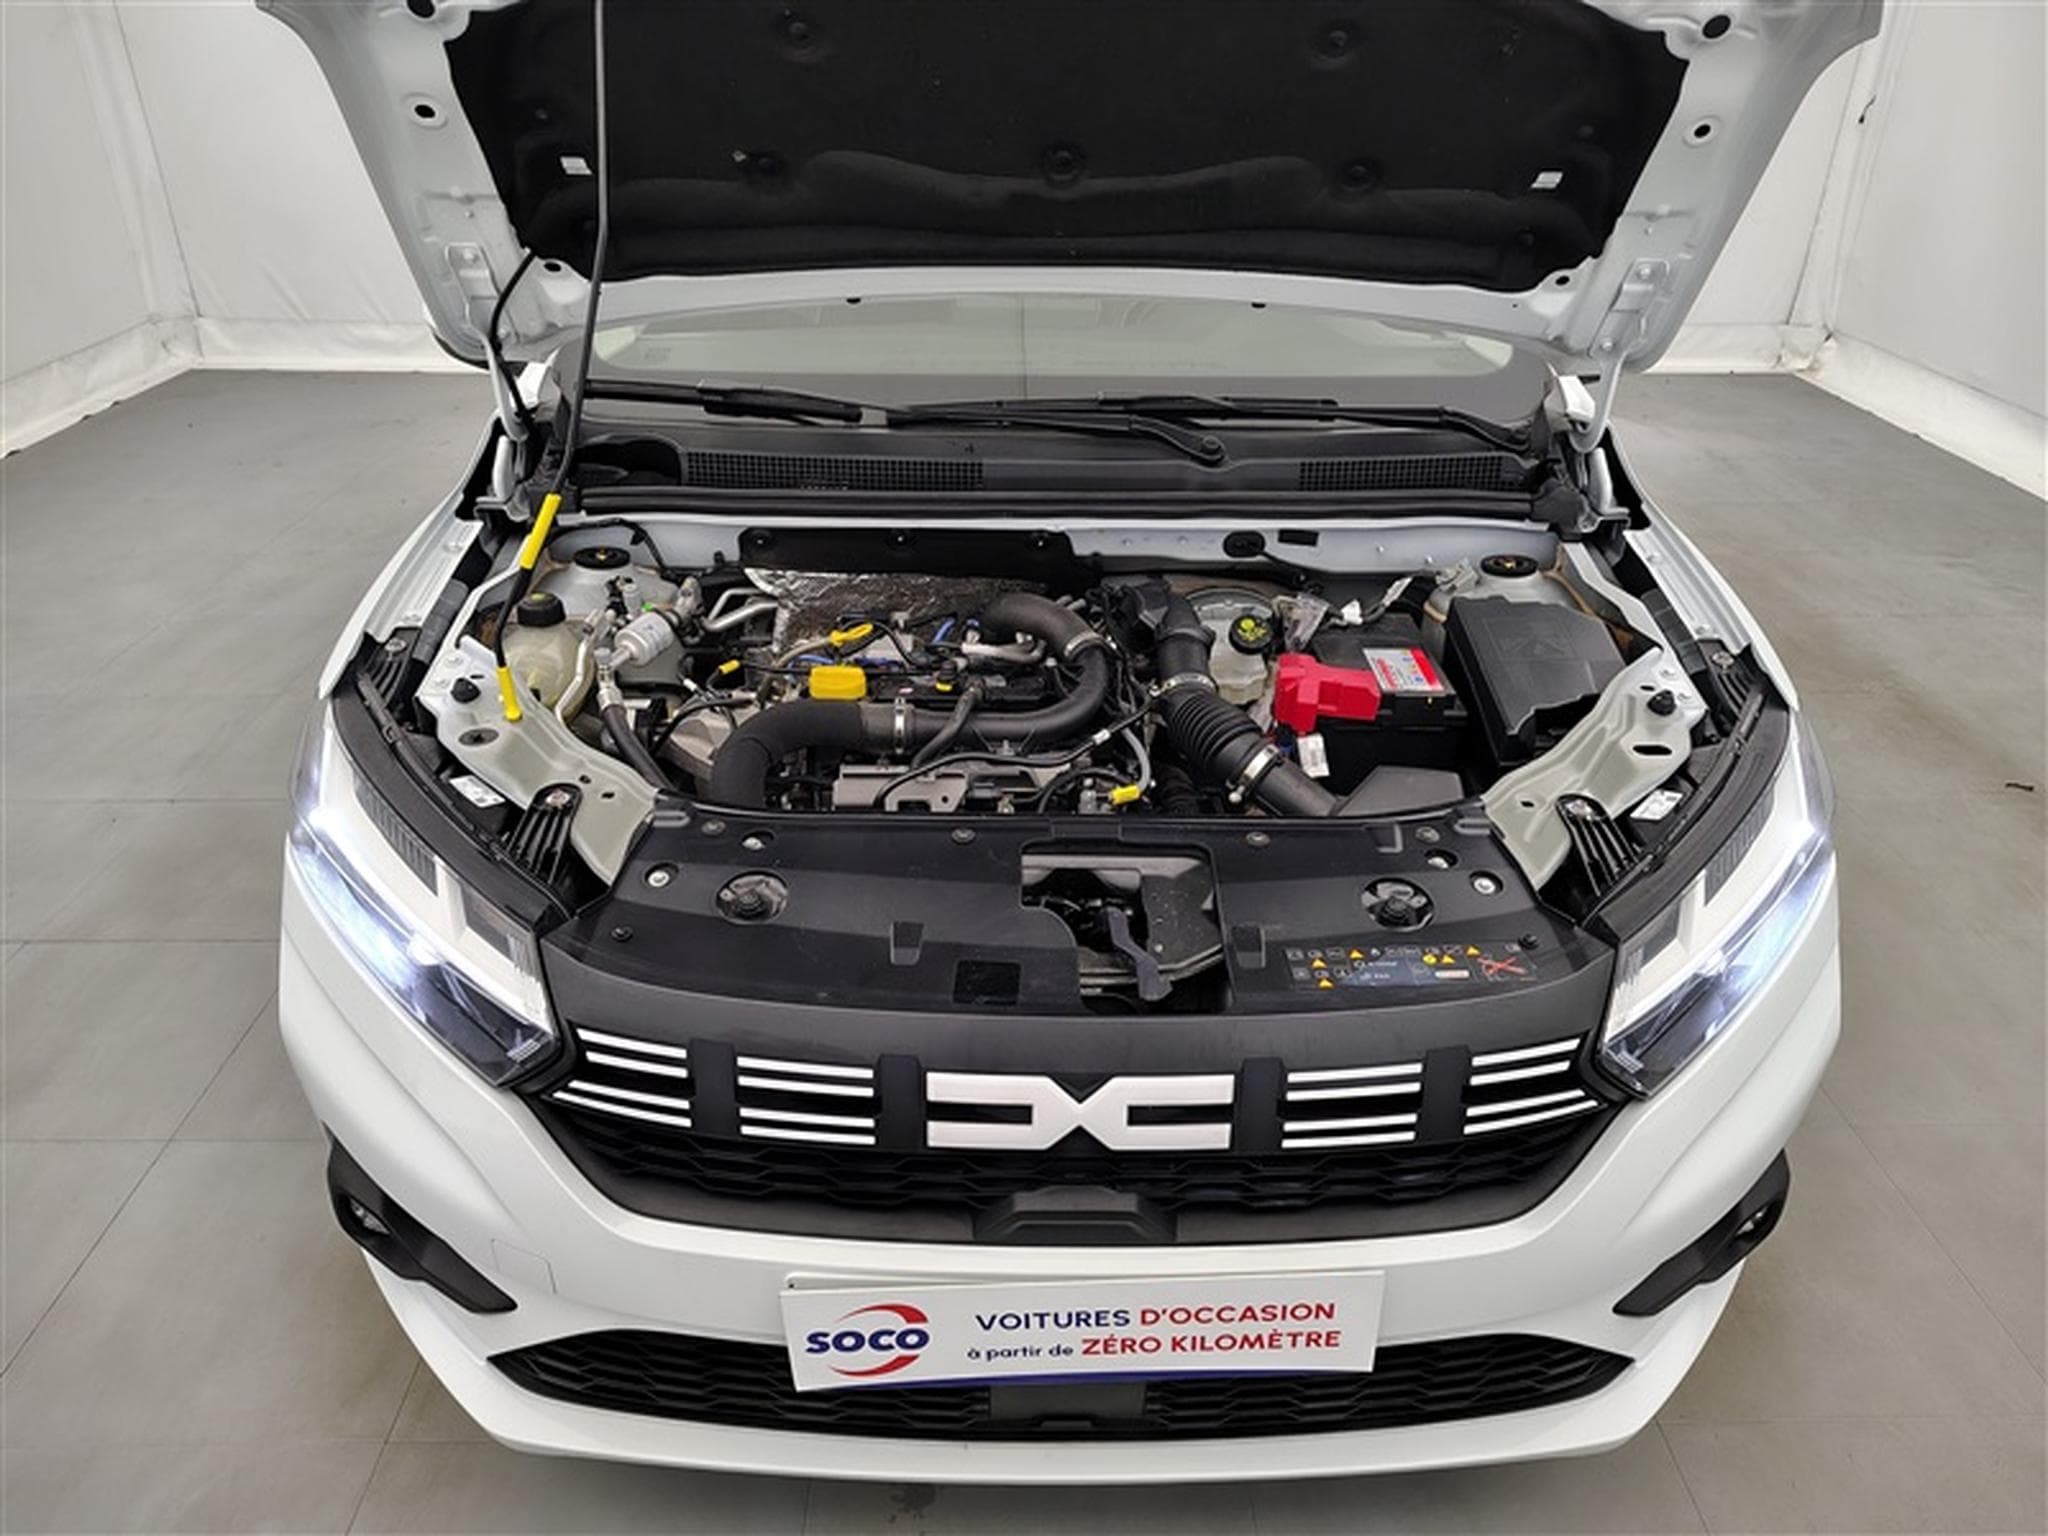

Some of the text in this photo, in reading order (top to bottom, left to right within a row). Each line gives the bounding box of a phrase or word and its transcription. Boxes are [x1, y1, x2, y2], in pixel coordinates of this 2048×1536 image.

[975, 1303, 1336, 1331] VOITURES D'OCCASION
[806, 1328, 930, 1354] SOCO
[967, 1329, 1342, 1362] à partir de ZÉRO KILOMÈTRE
